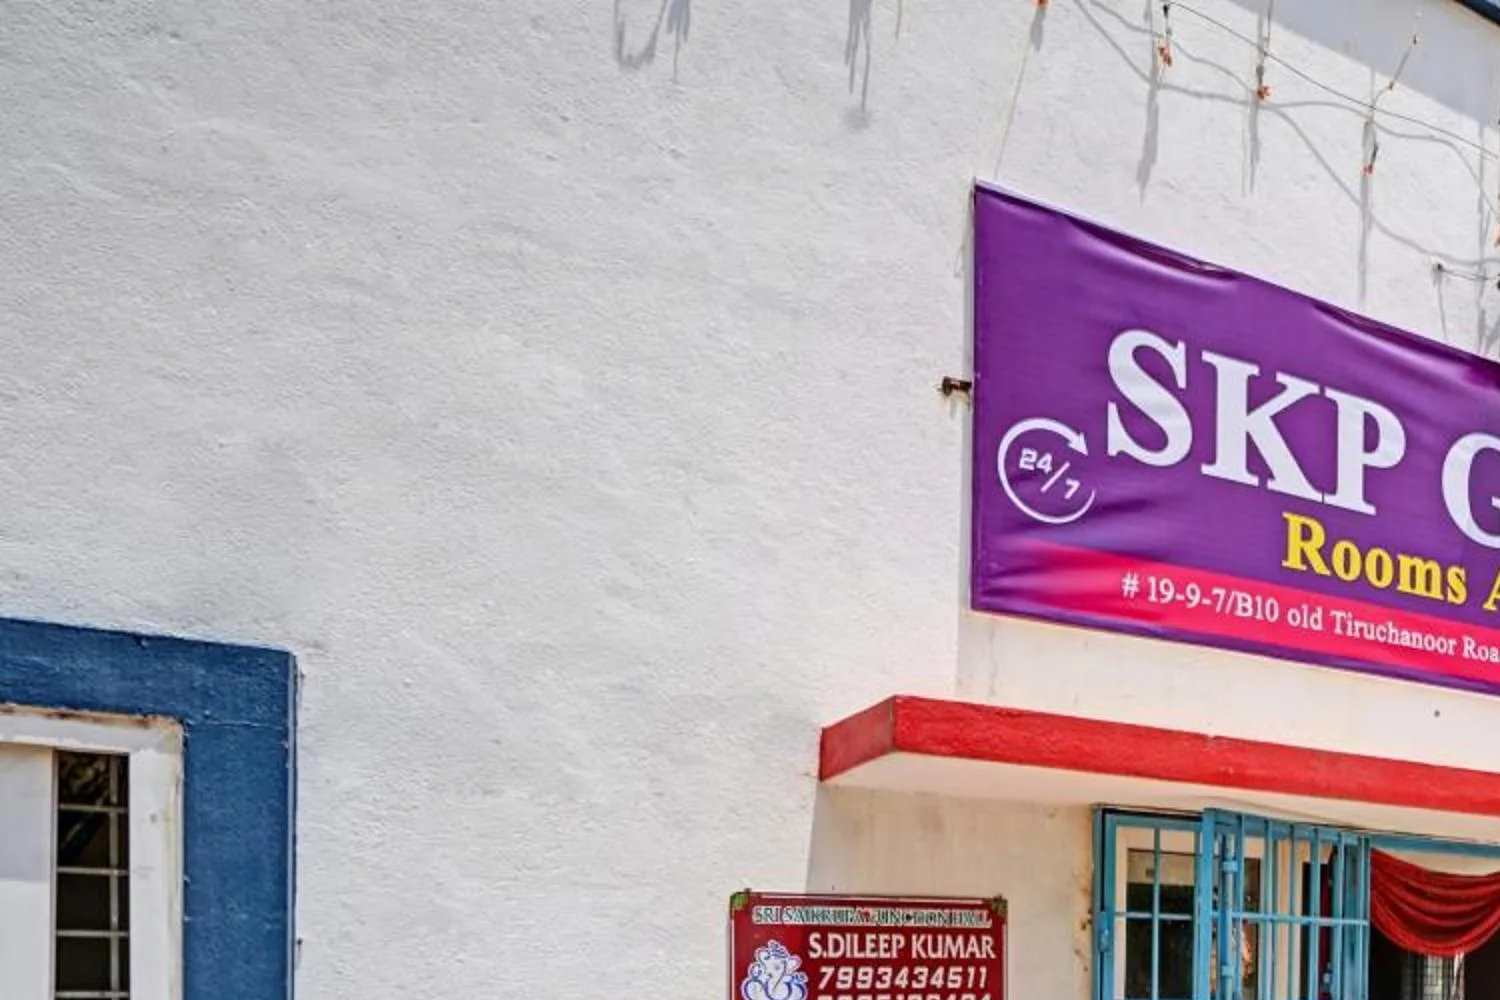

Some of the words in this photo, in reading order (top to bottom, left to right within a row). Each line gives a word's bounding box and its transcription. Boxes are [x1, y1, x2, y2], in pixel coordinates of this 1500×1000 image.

[1107, 329, 1406, 515] SKP
[1019, 447, 1080, 499] 24/7
[1281, 511, 1468, 605] Rooms
[1121, 572, 1140, 599] #
[1148, 576, 1280, 623] 19-9-7/B10
[1287, 603, 1323, 632] old
[1330, 610, 1457, 657] Tiruchanoor
[808, 932, 905, 960] S.DILEEP
[911, 934, 996, 960] KUMAR
[818, 966, 988, 990] 7993434511
